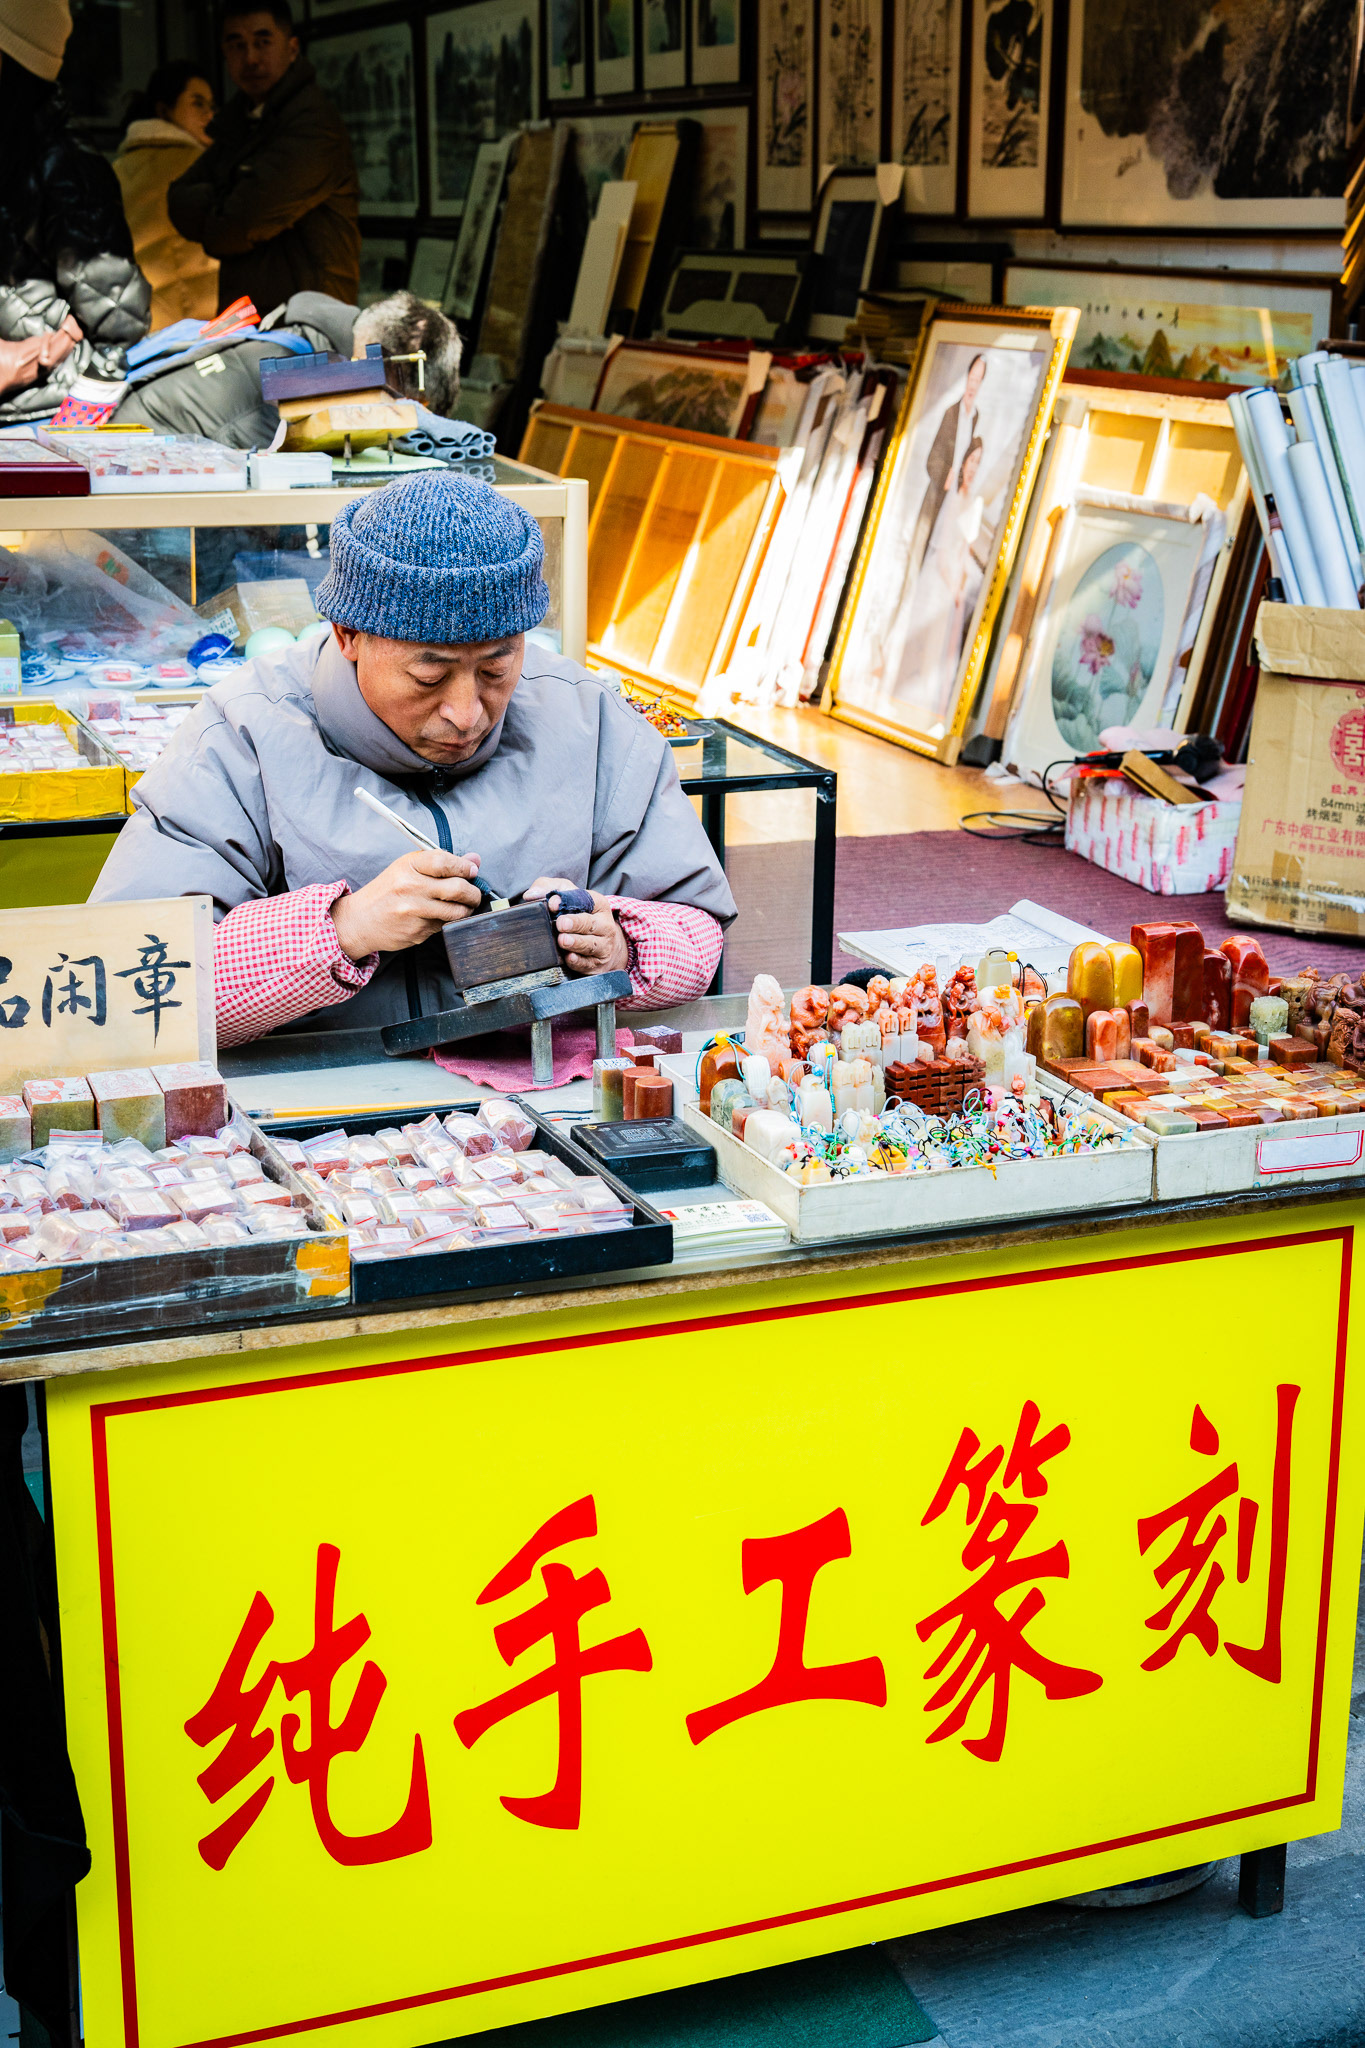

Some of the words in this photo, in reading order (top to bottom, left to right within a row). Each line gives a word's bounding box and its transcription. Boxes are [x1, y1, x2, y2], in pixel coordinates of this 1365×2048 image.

[1331, 784, 1365, 798] 经典
[1262, 818, 1365, 846] 广东中烟工业有限
[184, 1384, 1301, 1871] 纯手工篆刻
